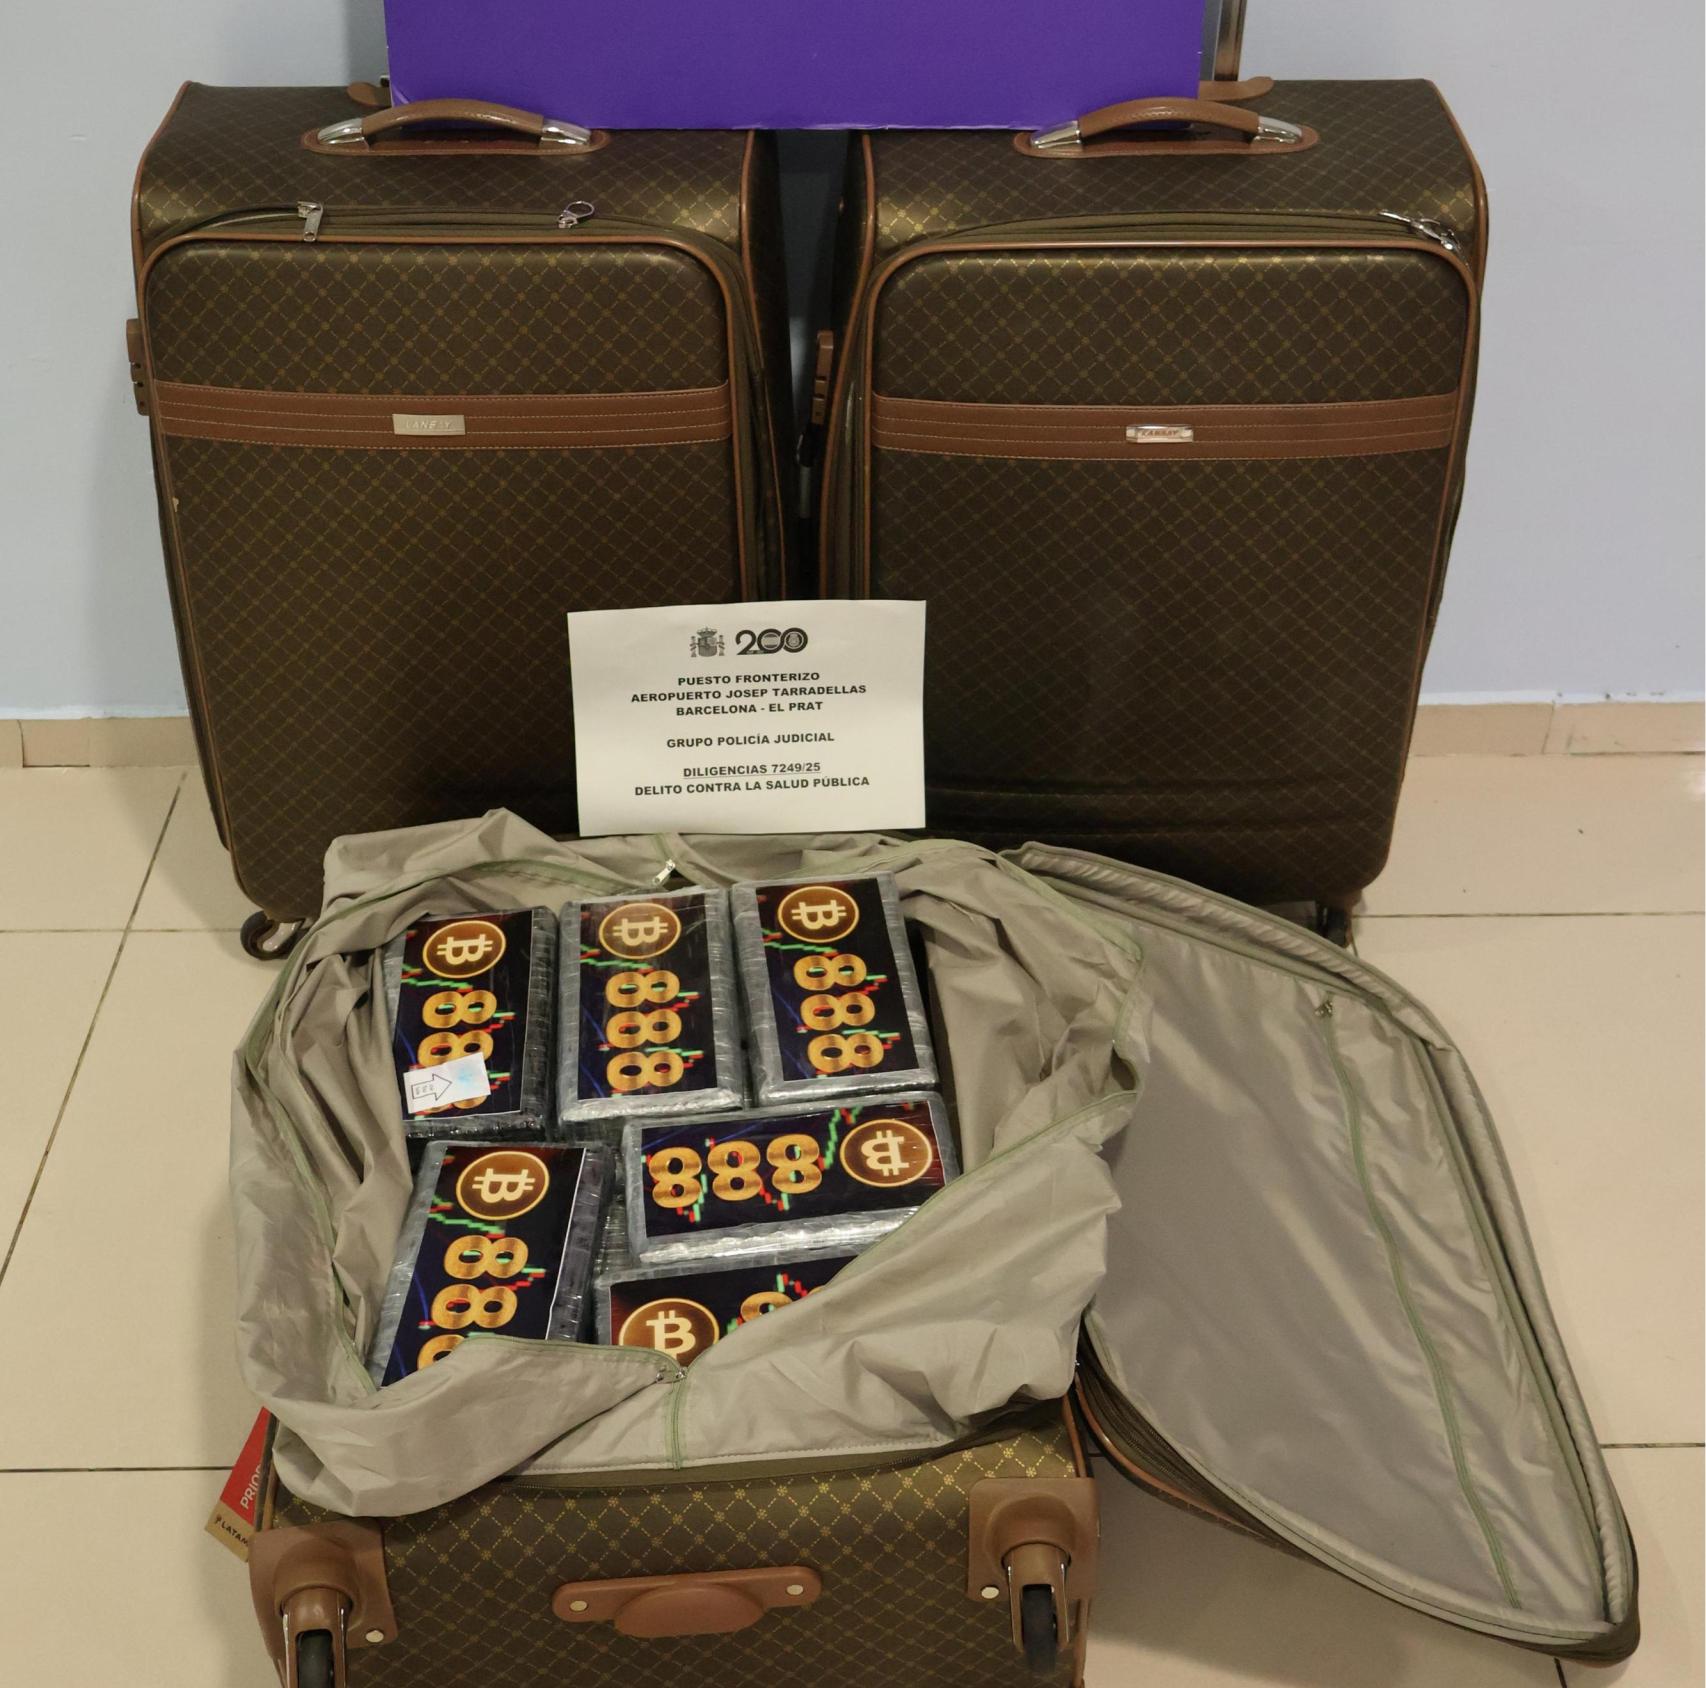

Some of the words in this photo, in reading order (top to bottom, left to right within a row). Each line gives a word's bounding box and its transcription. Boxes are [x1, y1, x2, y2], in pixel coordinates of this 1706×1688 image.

[678, 675, 732, 687] PUESTO
[735, 672, 821, 684] FRONTERIZO
[631, 690, 722, 703] AEROPUERTO
[726, 688, 768, 699] JOSEP
[772, 685, 867, 697] TARRADELLAS
[676, 704, 757, 716] BARCELONA
[768, 703, 785, 712] EL
[789, 701, 824, 712] PRAT
[667, 737, 713, 748] GRUPO
[717, 733, 770, 746] POLICÍA
[774, 732, 835, 744] JUDICIAL
[683, 764, 768, 777] DILIGENCIAS
[771, 762, 821, 773] 7249/25
[635, 785, 682, 796] DELITO
[686, 782, 742, 794] CONTRA
[745, 781, 762, 791] LA
[766, 779, 809, 790] SALUD
[813, 776, 870, 788] PÚBLICA
